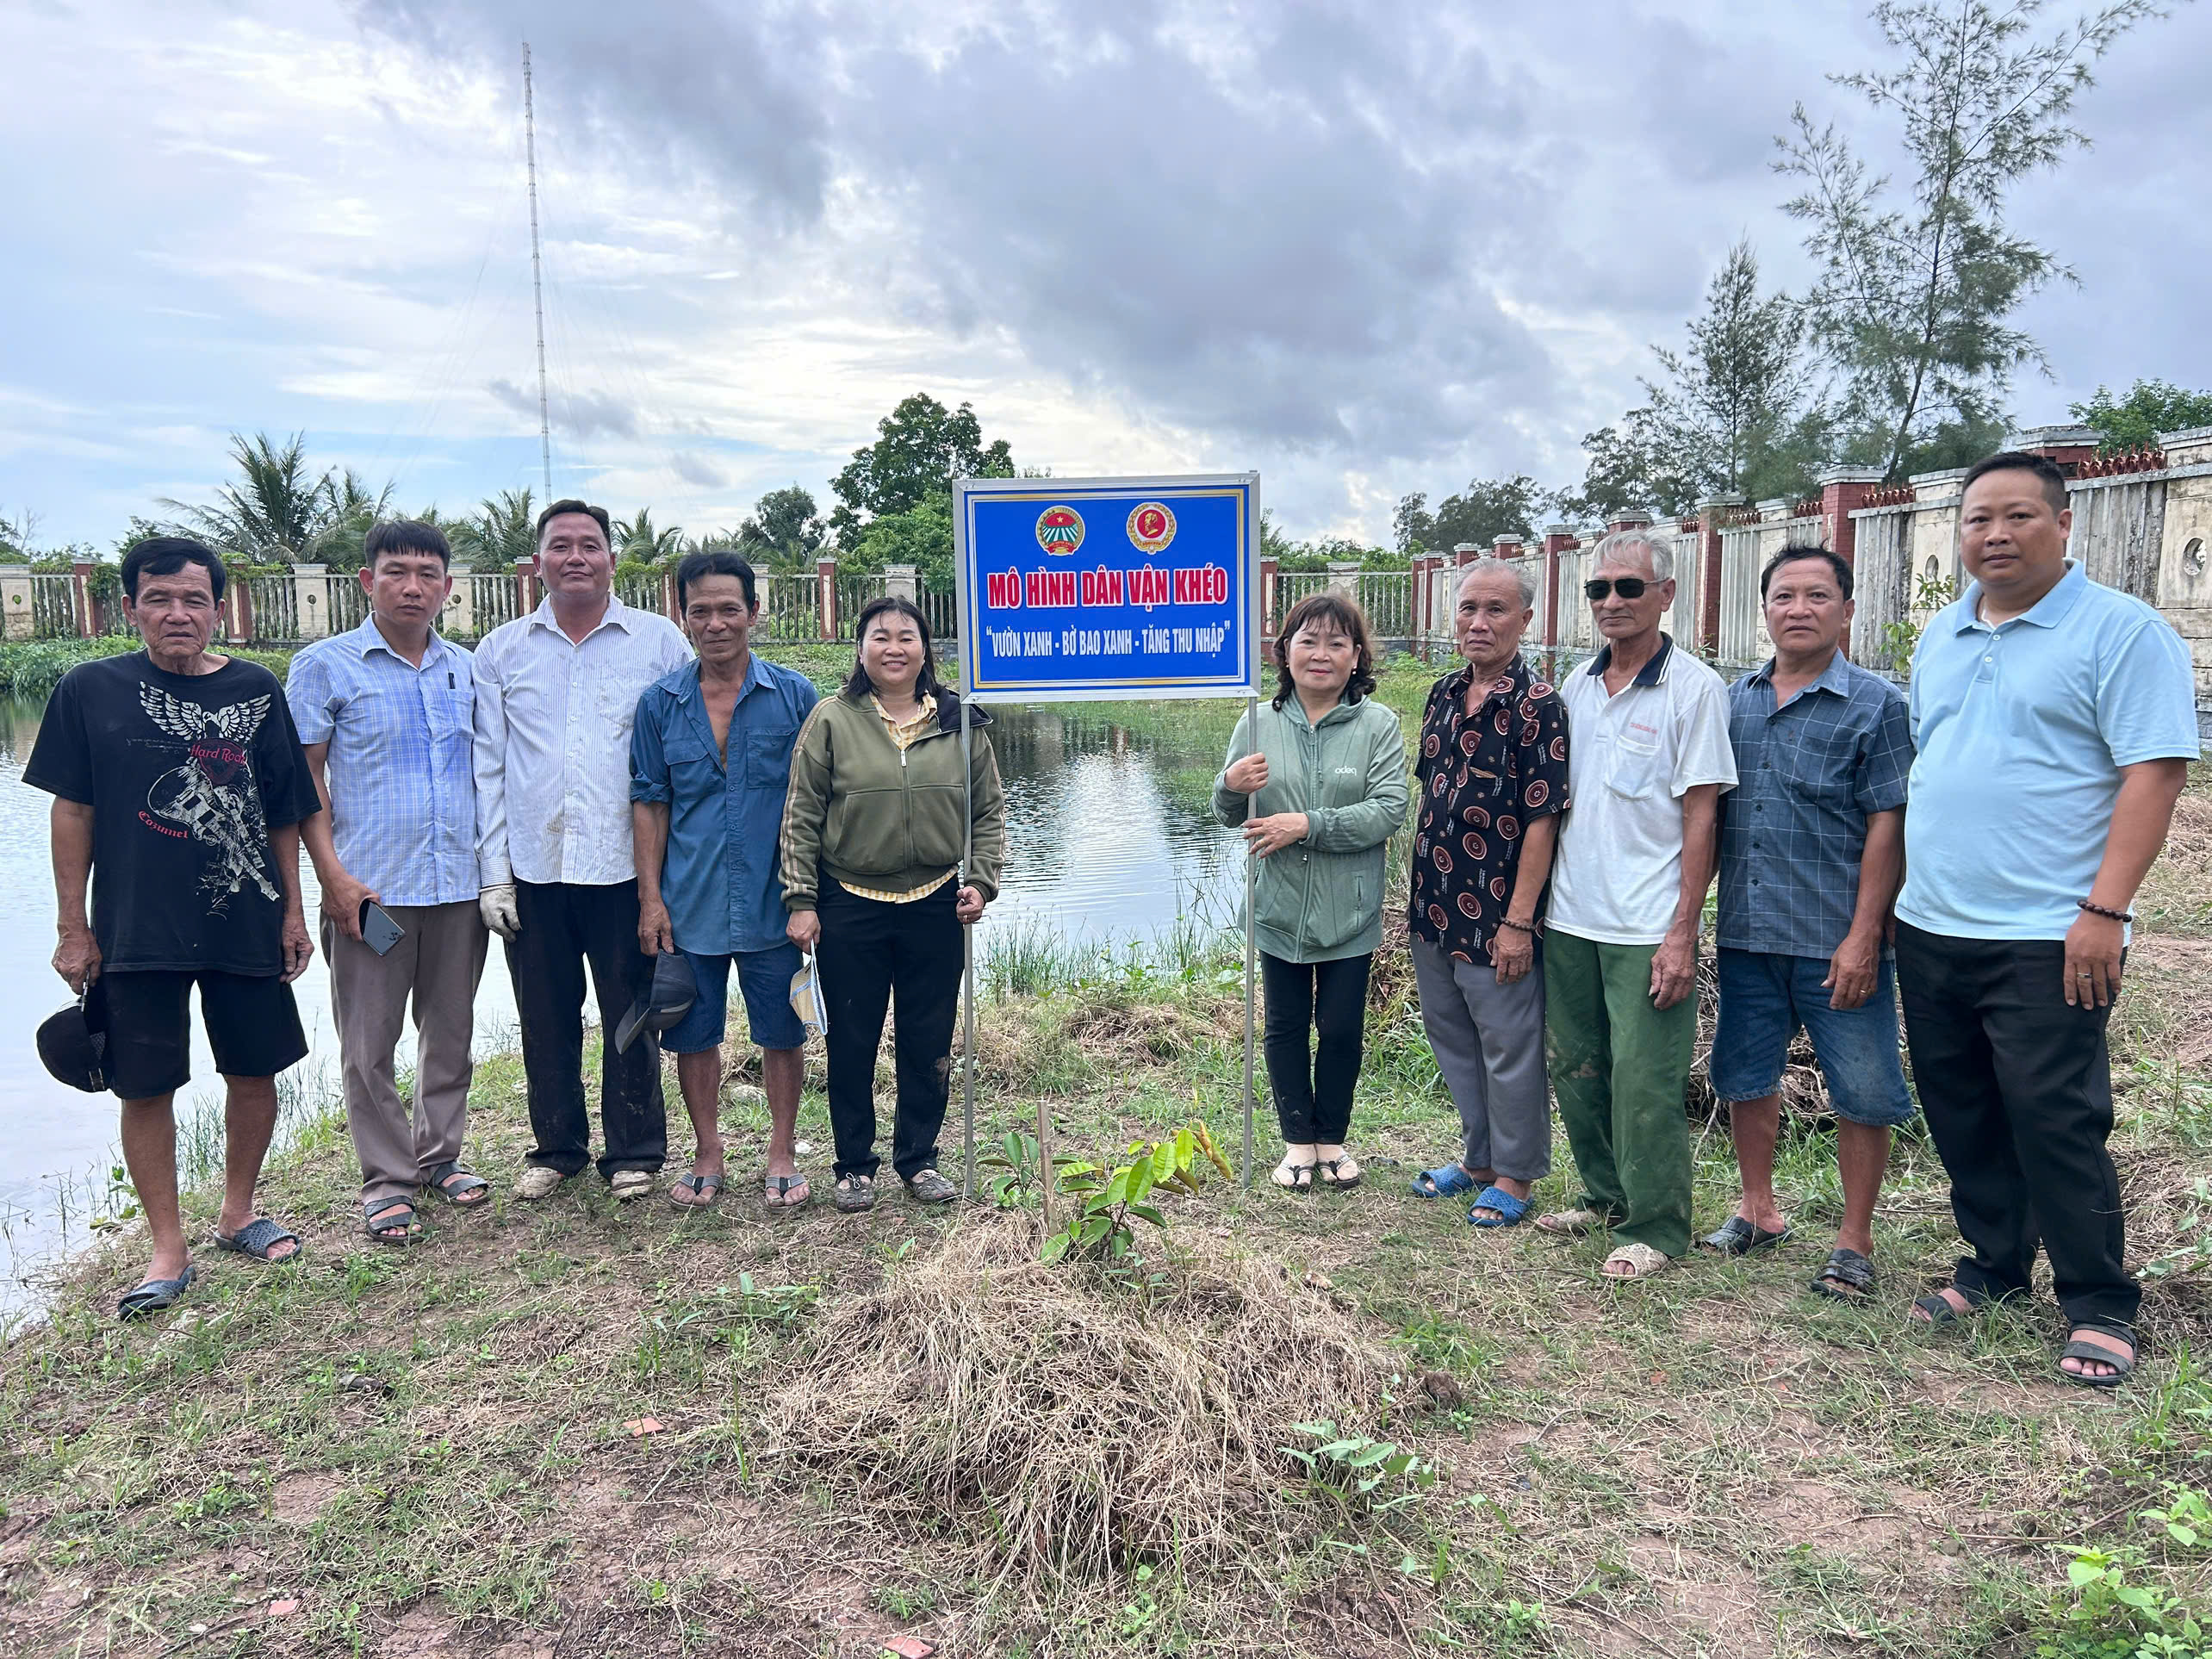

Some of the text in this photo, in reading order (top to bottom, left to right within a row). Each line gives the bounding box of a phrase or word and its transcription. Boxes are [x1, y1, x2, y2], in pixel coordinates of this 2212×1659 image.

[987, 562, 1228, 612] MÔ HÌNH DÂN VẬN KHÉO
[1023, 631, 1053, 656] XANH
[1062, 624, 1077, 656] BỜ
[1079, 630, 1101, 656] BAO
[1103, 629, 1133, 655] XANH
[1141, 624, 1171, 654] TĂNG
[1172, 628, 1192, 653] THU
[191, 744, 221, 759] Hard
